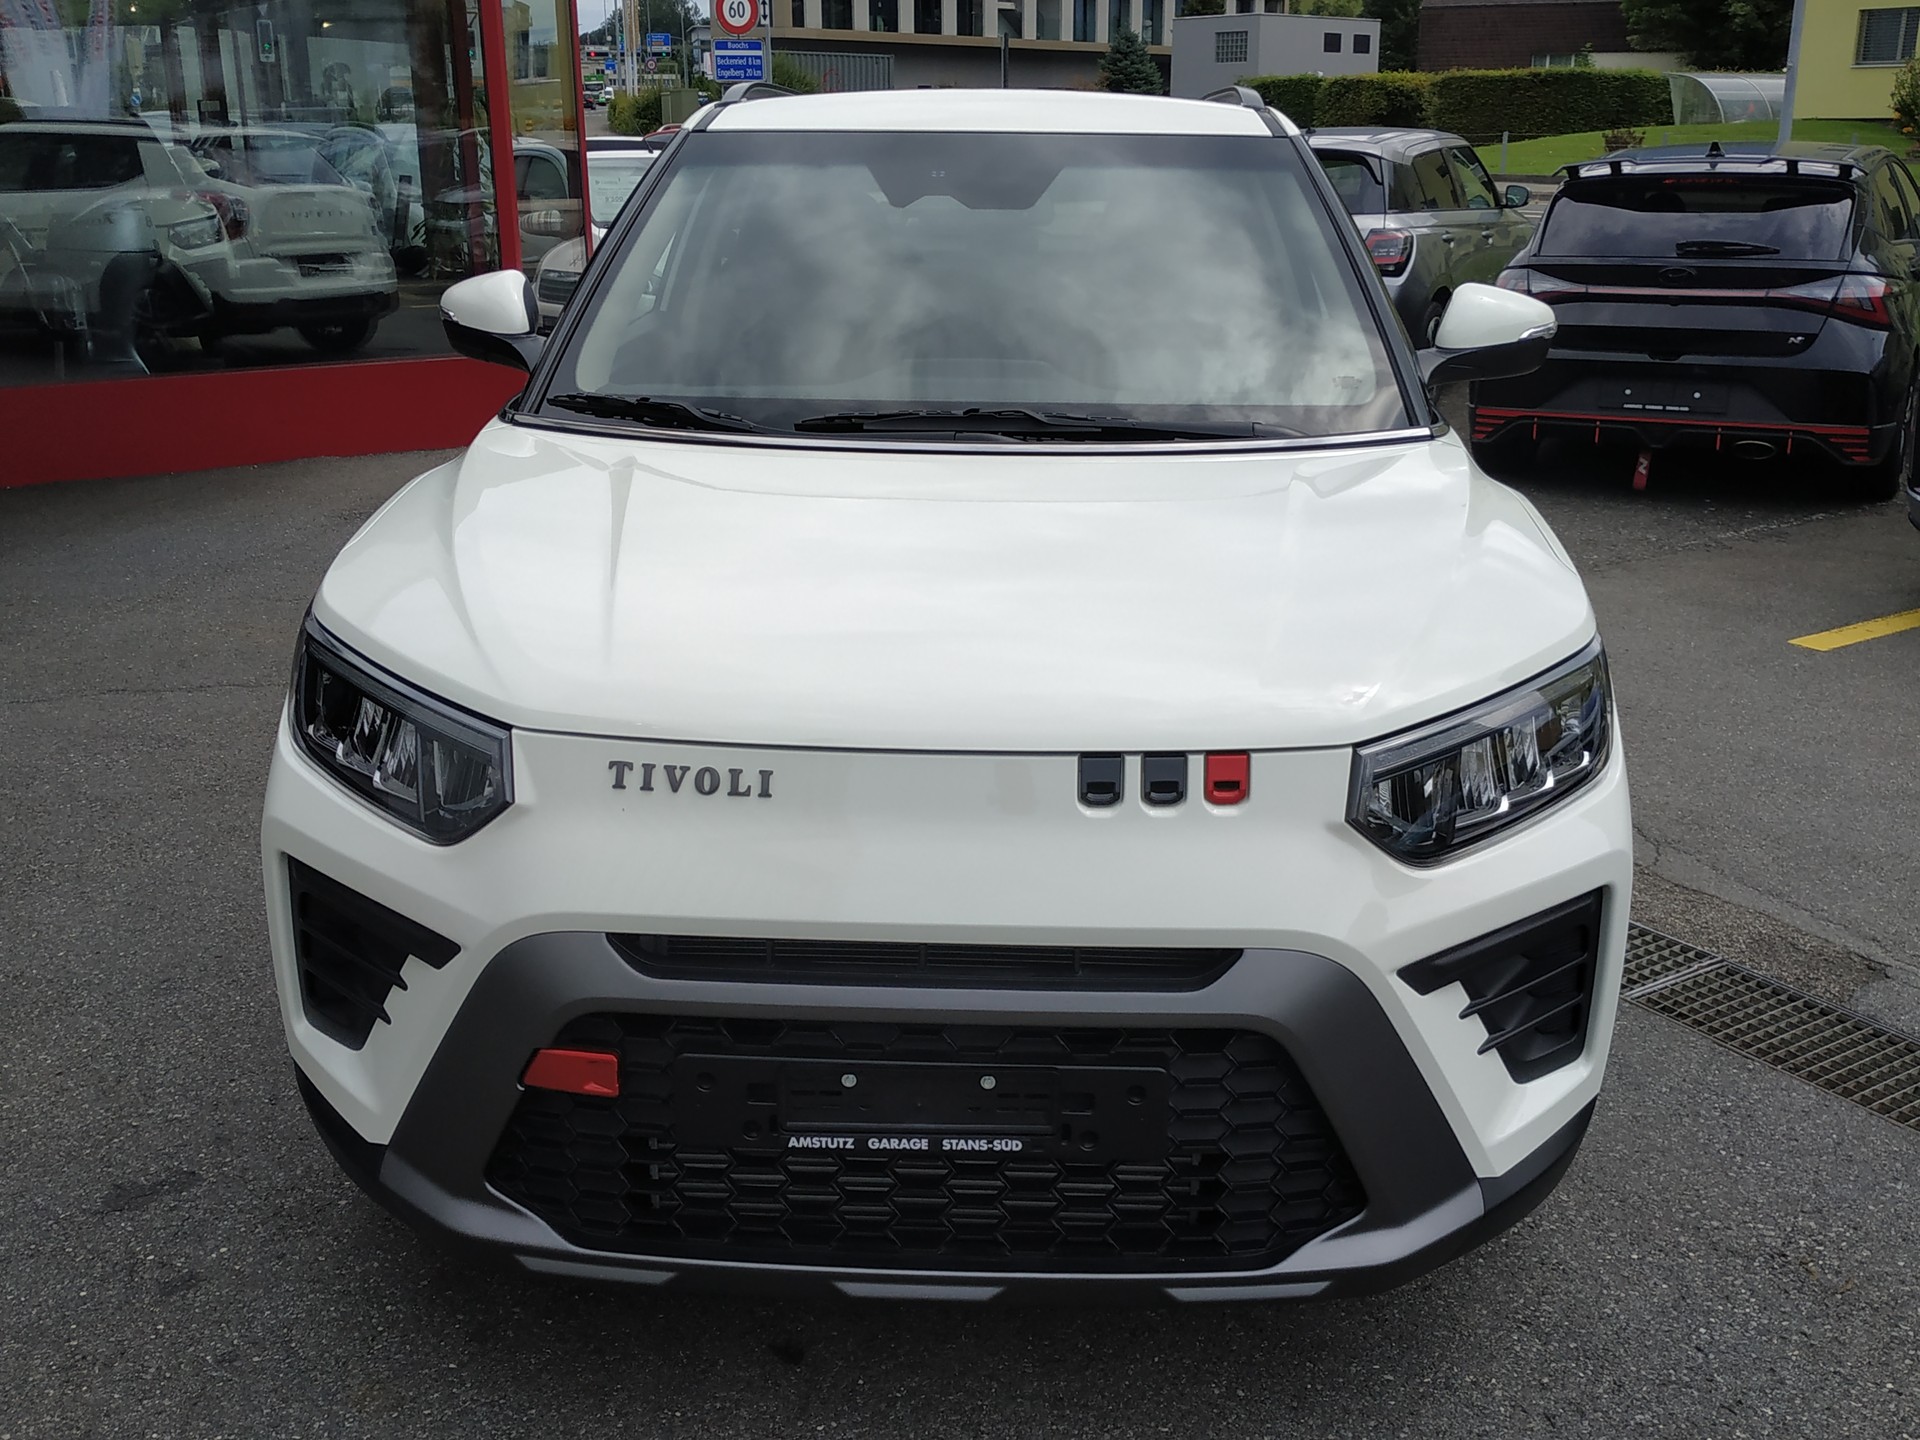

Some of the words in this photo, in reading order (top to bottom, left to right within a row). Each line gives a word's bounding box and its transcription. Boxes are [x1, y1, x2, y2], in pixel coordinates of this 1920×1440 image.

[729, 1, 745, 18] 60
[727, 41, 749, 49] Buochs
[717, 57, 746, 65] Beckenried
[753, 57, 761, 65] km
[717, 68, 745, 78] Engelberg
[746, 68, 752, 76] 20
[753, 68, 761, 76] km
[608, 760, 774, 798] TIVOLI
[788, 1136, 855, 1149] AMSTUTZ
[867, 1138, 929, 1150] GARAGE
[942, 1138, 1023, 1151] STANS-SÜD
